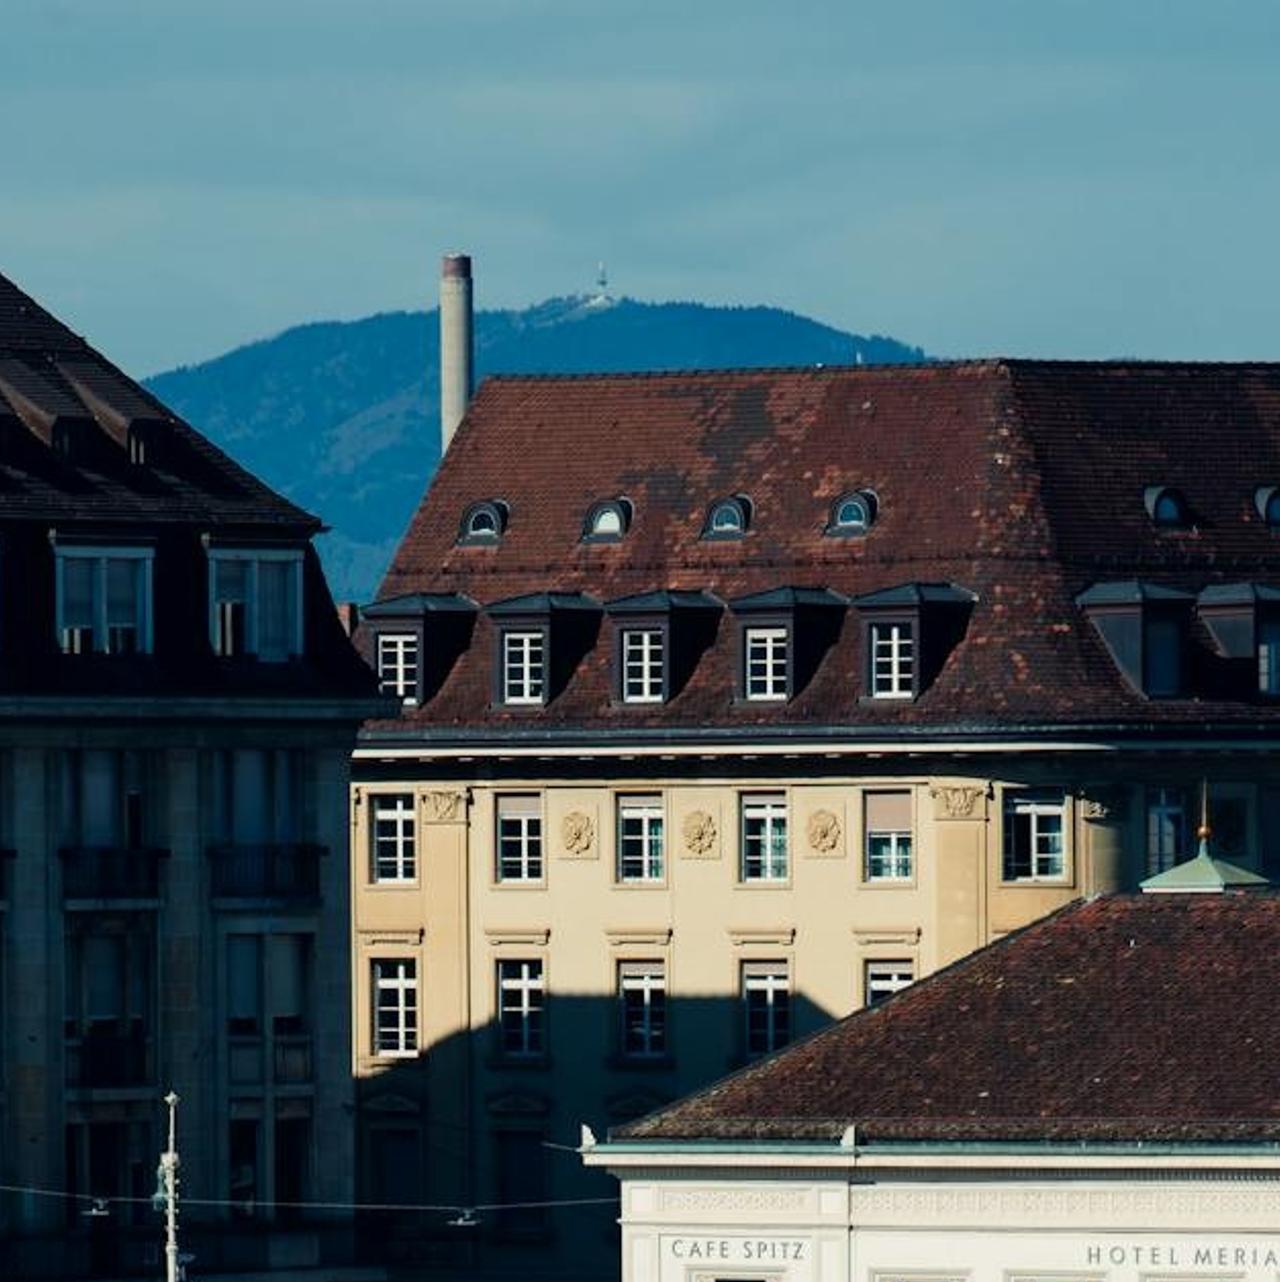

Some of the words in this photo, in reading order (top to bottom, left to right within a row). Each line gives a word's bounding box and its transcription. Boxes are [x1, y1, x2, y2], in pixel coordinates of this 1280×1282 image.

[672, 1239, 729, 1259] CAFE
[743, 1241, 805, 1260] SPITZ
[1087, 1246, 1179, 1266] HOTEL
